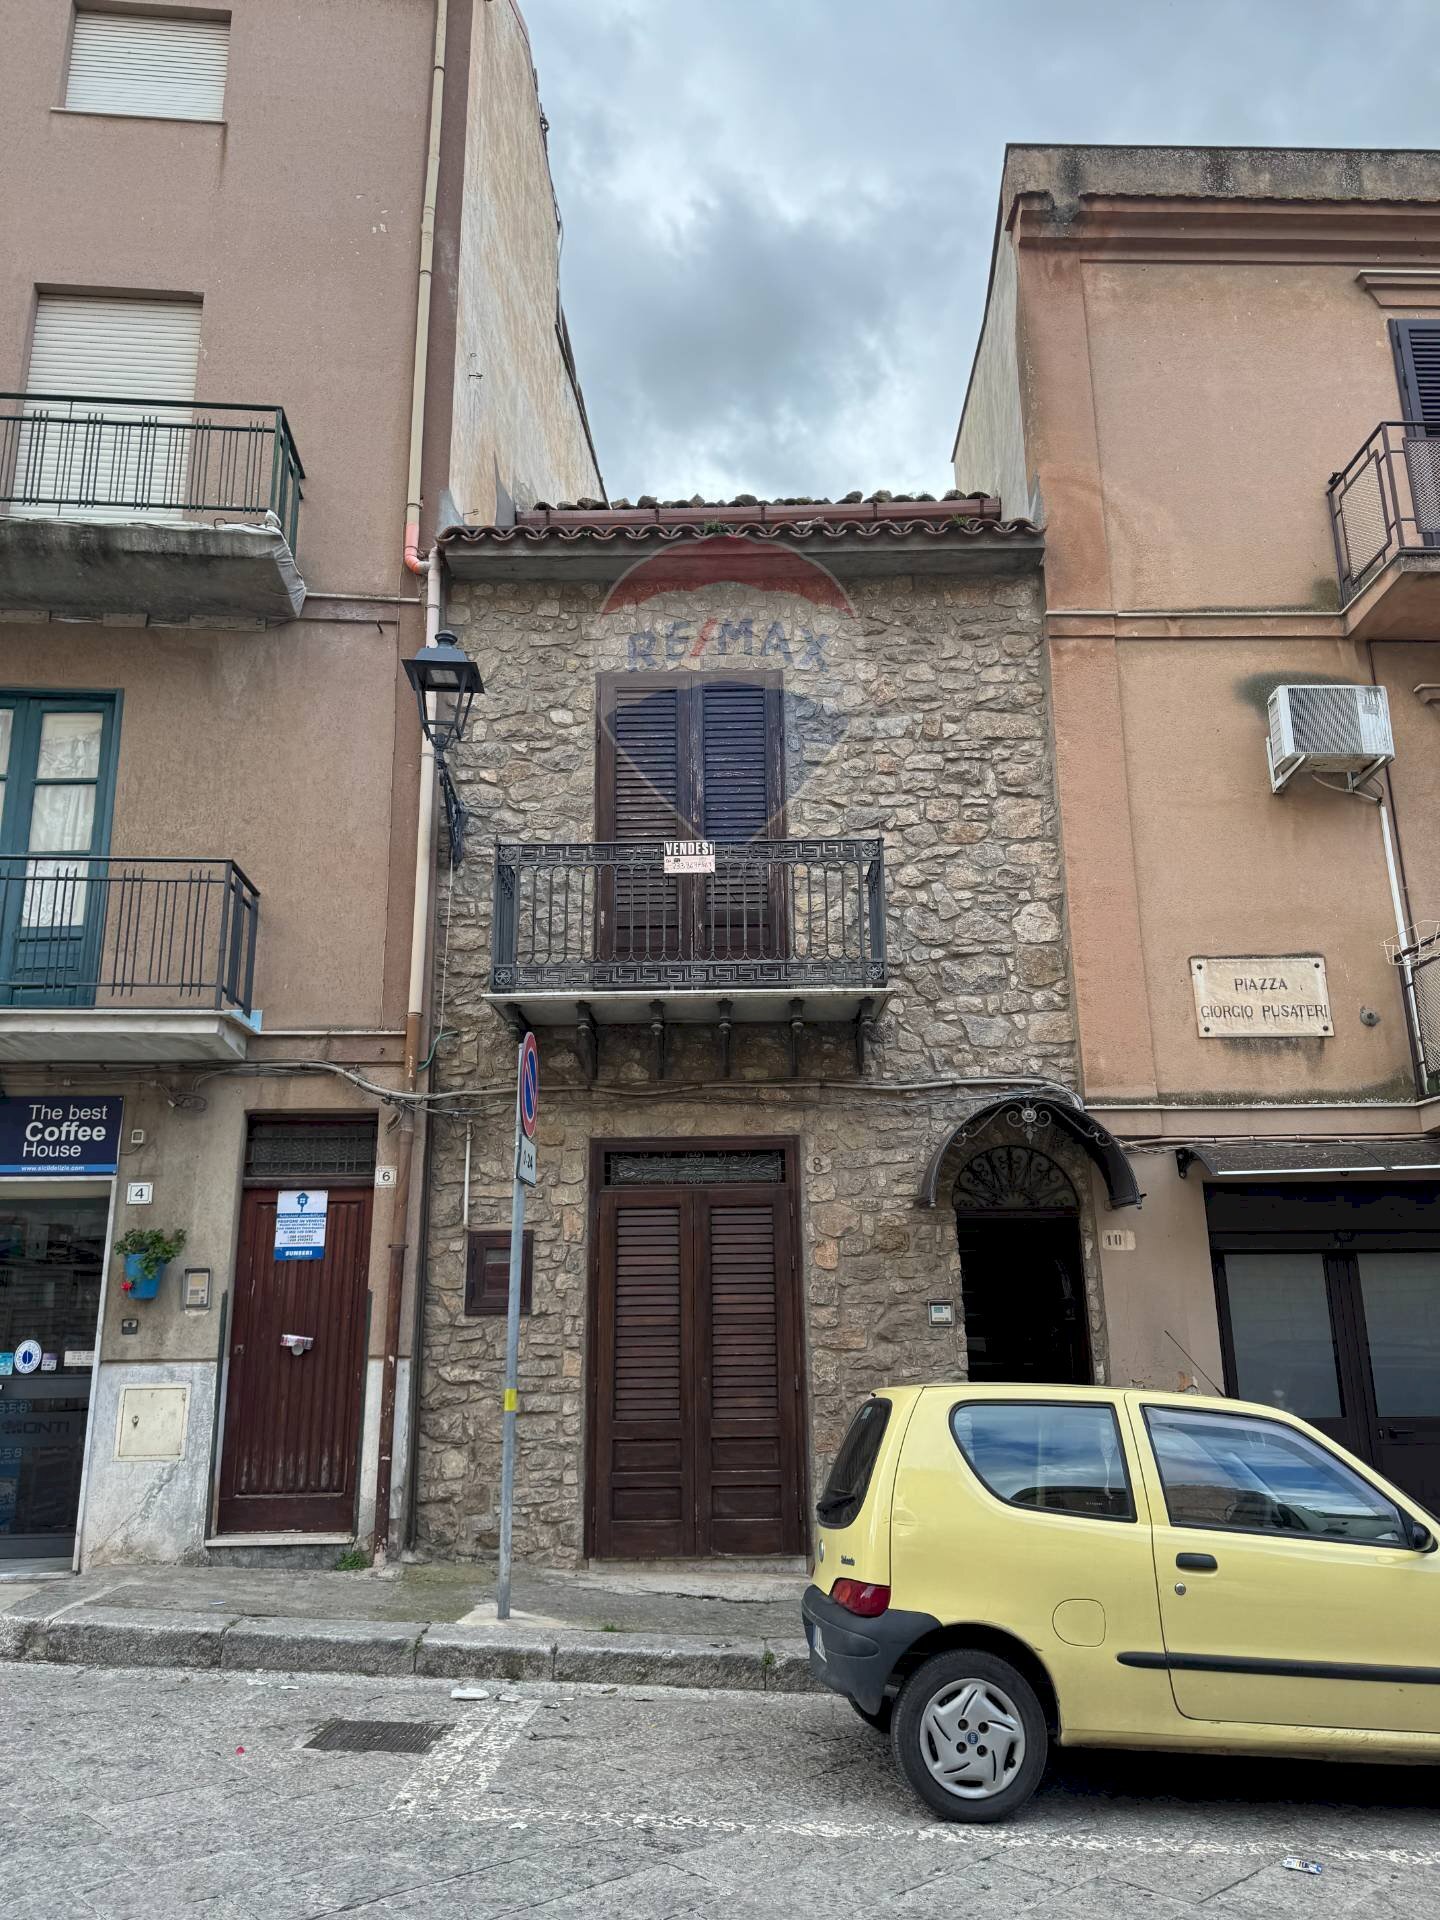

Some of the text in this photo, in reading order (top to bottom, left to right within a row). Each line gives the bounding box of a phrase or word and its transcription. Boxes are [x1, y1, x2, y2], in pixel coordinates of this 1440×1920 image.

[665, 842, 714, 856] VENDESI
[1234, 977, 1288, 991] PIAZZA
[1201, 1004, 1328, 1019] GIORGIO PUSATERI
[29, 1104, 108, 1120] The best
[25, 1121, 107, 1142] Coffee
[22, 1141, 82, 1158] House
[813, 1157, 822, 1172] 8
[382, 1171, 391, 1182] 6
[134, 1187, 145, 1199] 4
